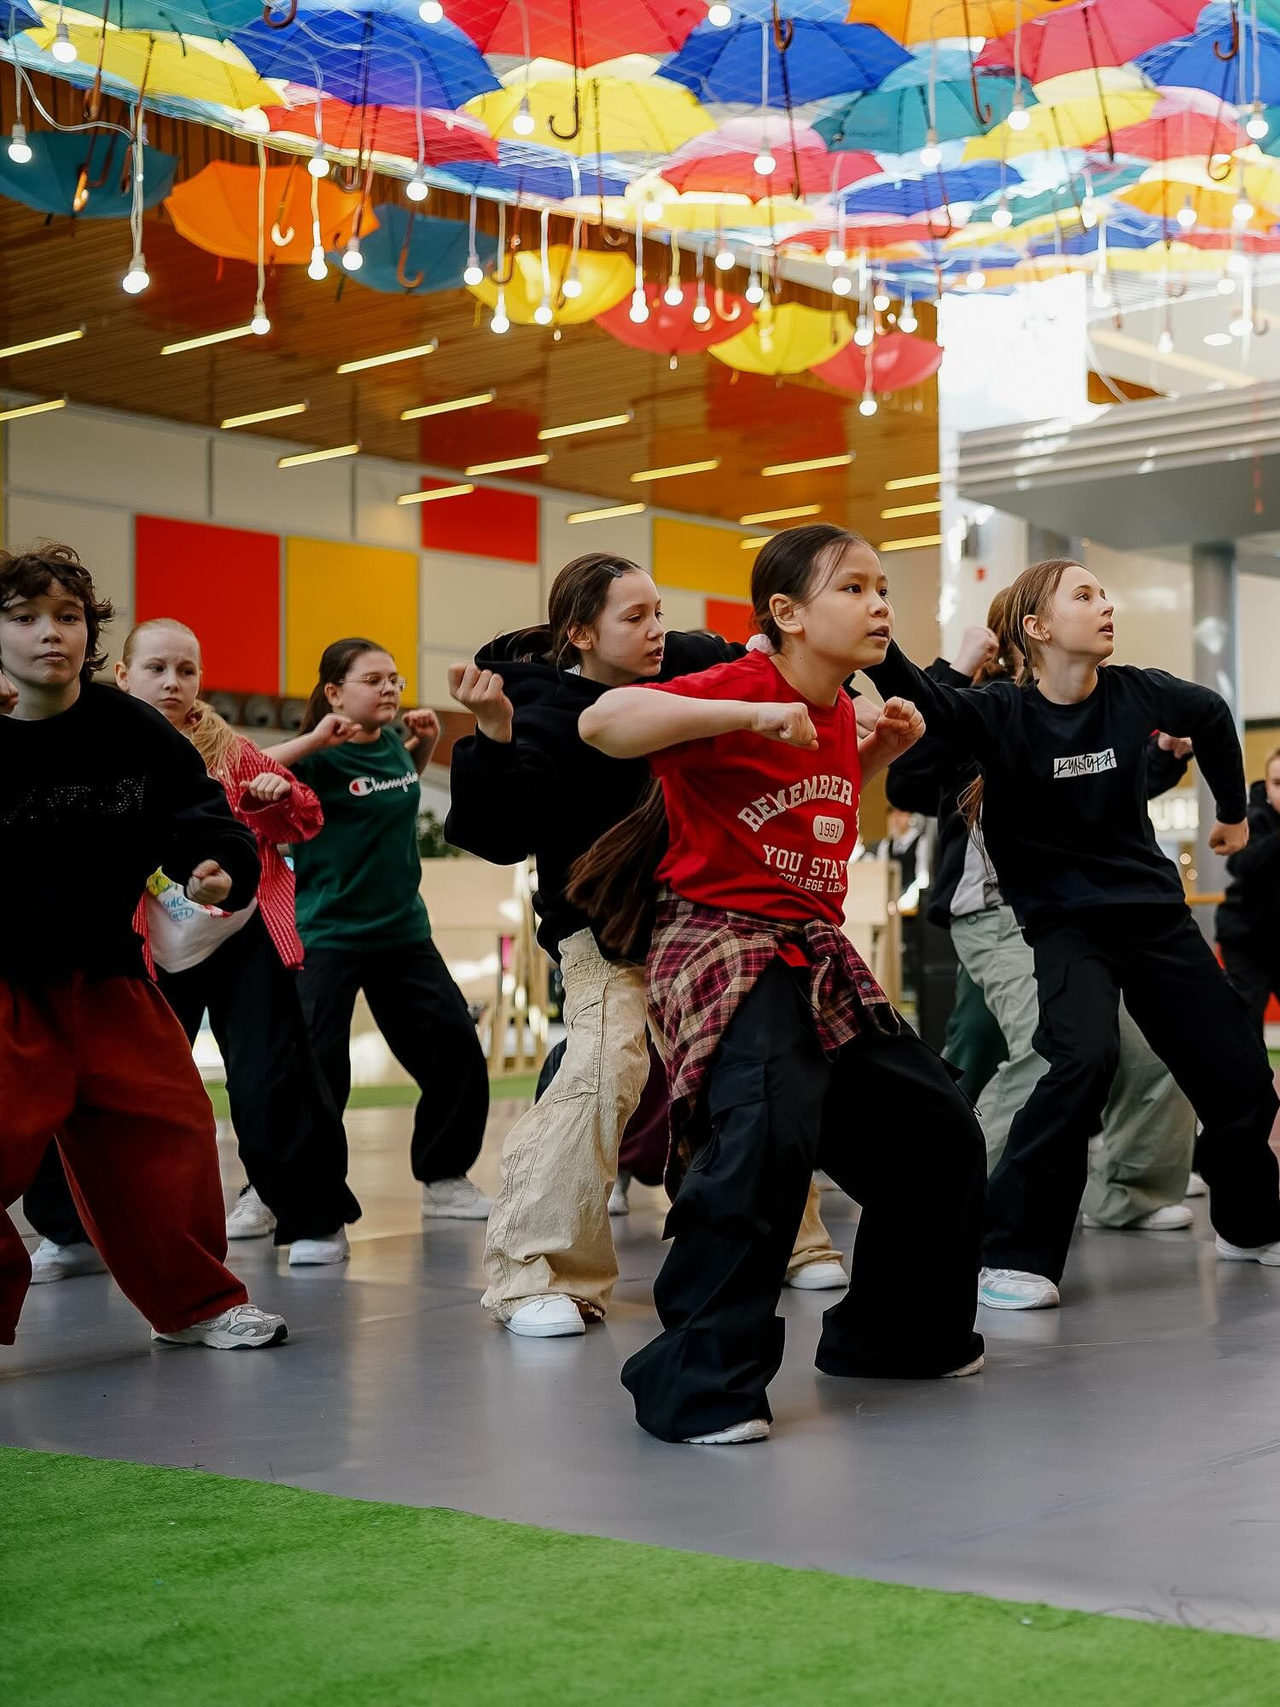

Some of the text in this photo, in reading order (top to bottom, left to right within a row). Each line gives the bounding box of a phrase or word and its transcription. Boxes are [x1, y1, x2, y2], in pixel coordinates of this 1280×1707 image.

[737, 775, 853, 833] REMEMBER
[819, 821, 841, 838] 1991
[762, 844, 804, 873] YOU
